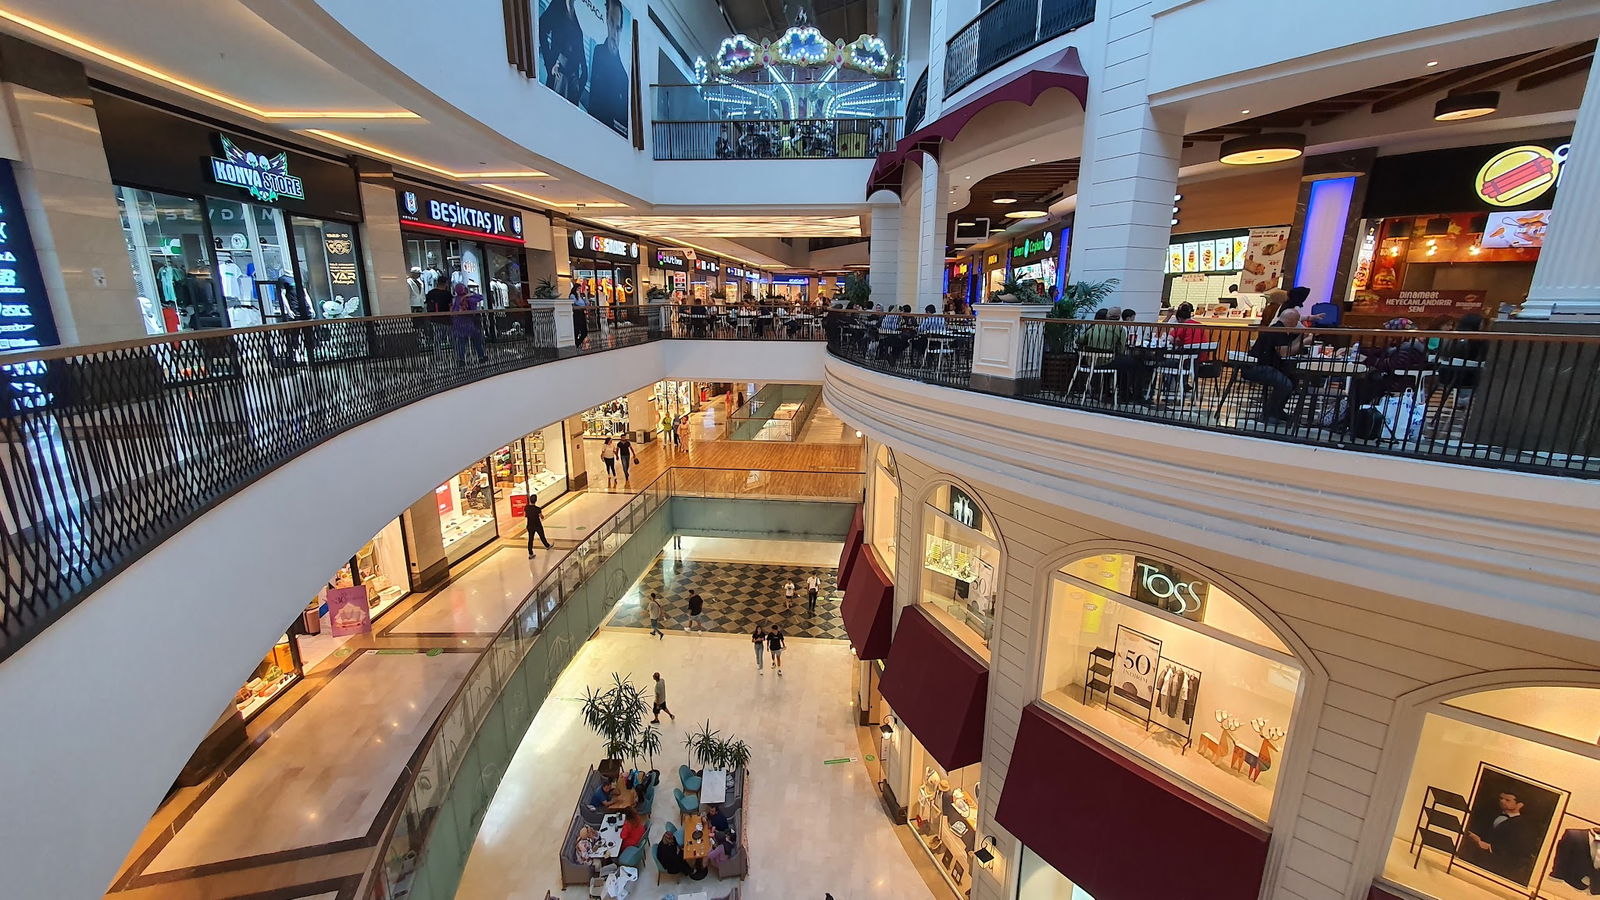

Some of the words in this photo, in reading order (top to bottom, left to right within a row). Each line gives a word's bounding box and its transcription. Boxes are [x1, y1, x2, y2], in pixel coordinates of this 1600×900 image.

[215, 160, 263, 188] KONYA
[261, 171, 303, 197] STORE
[430, 200, 492, 233] BEŞİKTAŞ
[494, 213, 506, 235] JK
[1137, 562, 1203, 614] TOSS
[1123, 650, 1151, 676] 50
